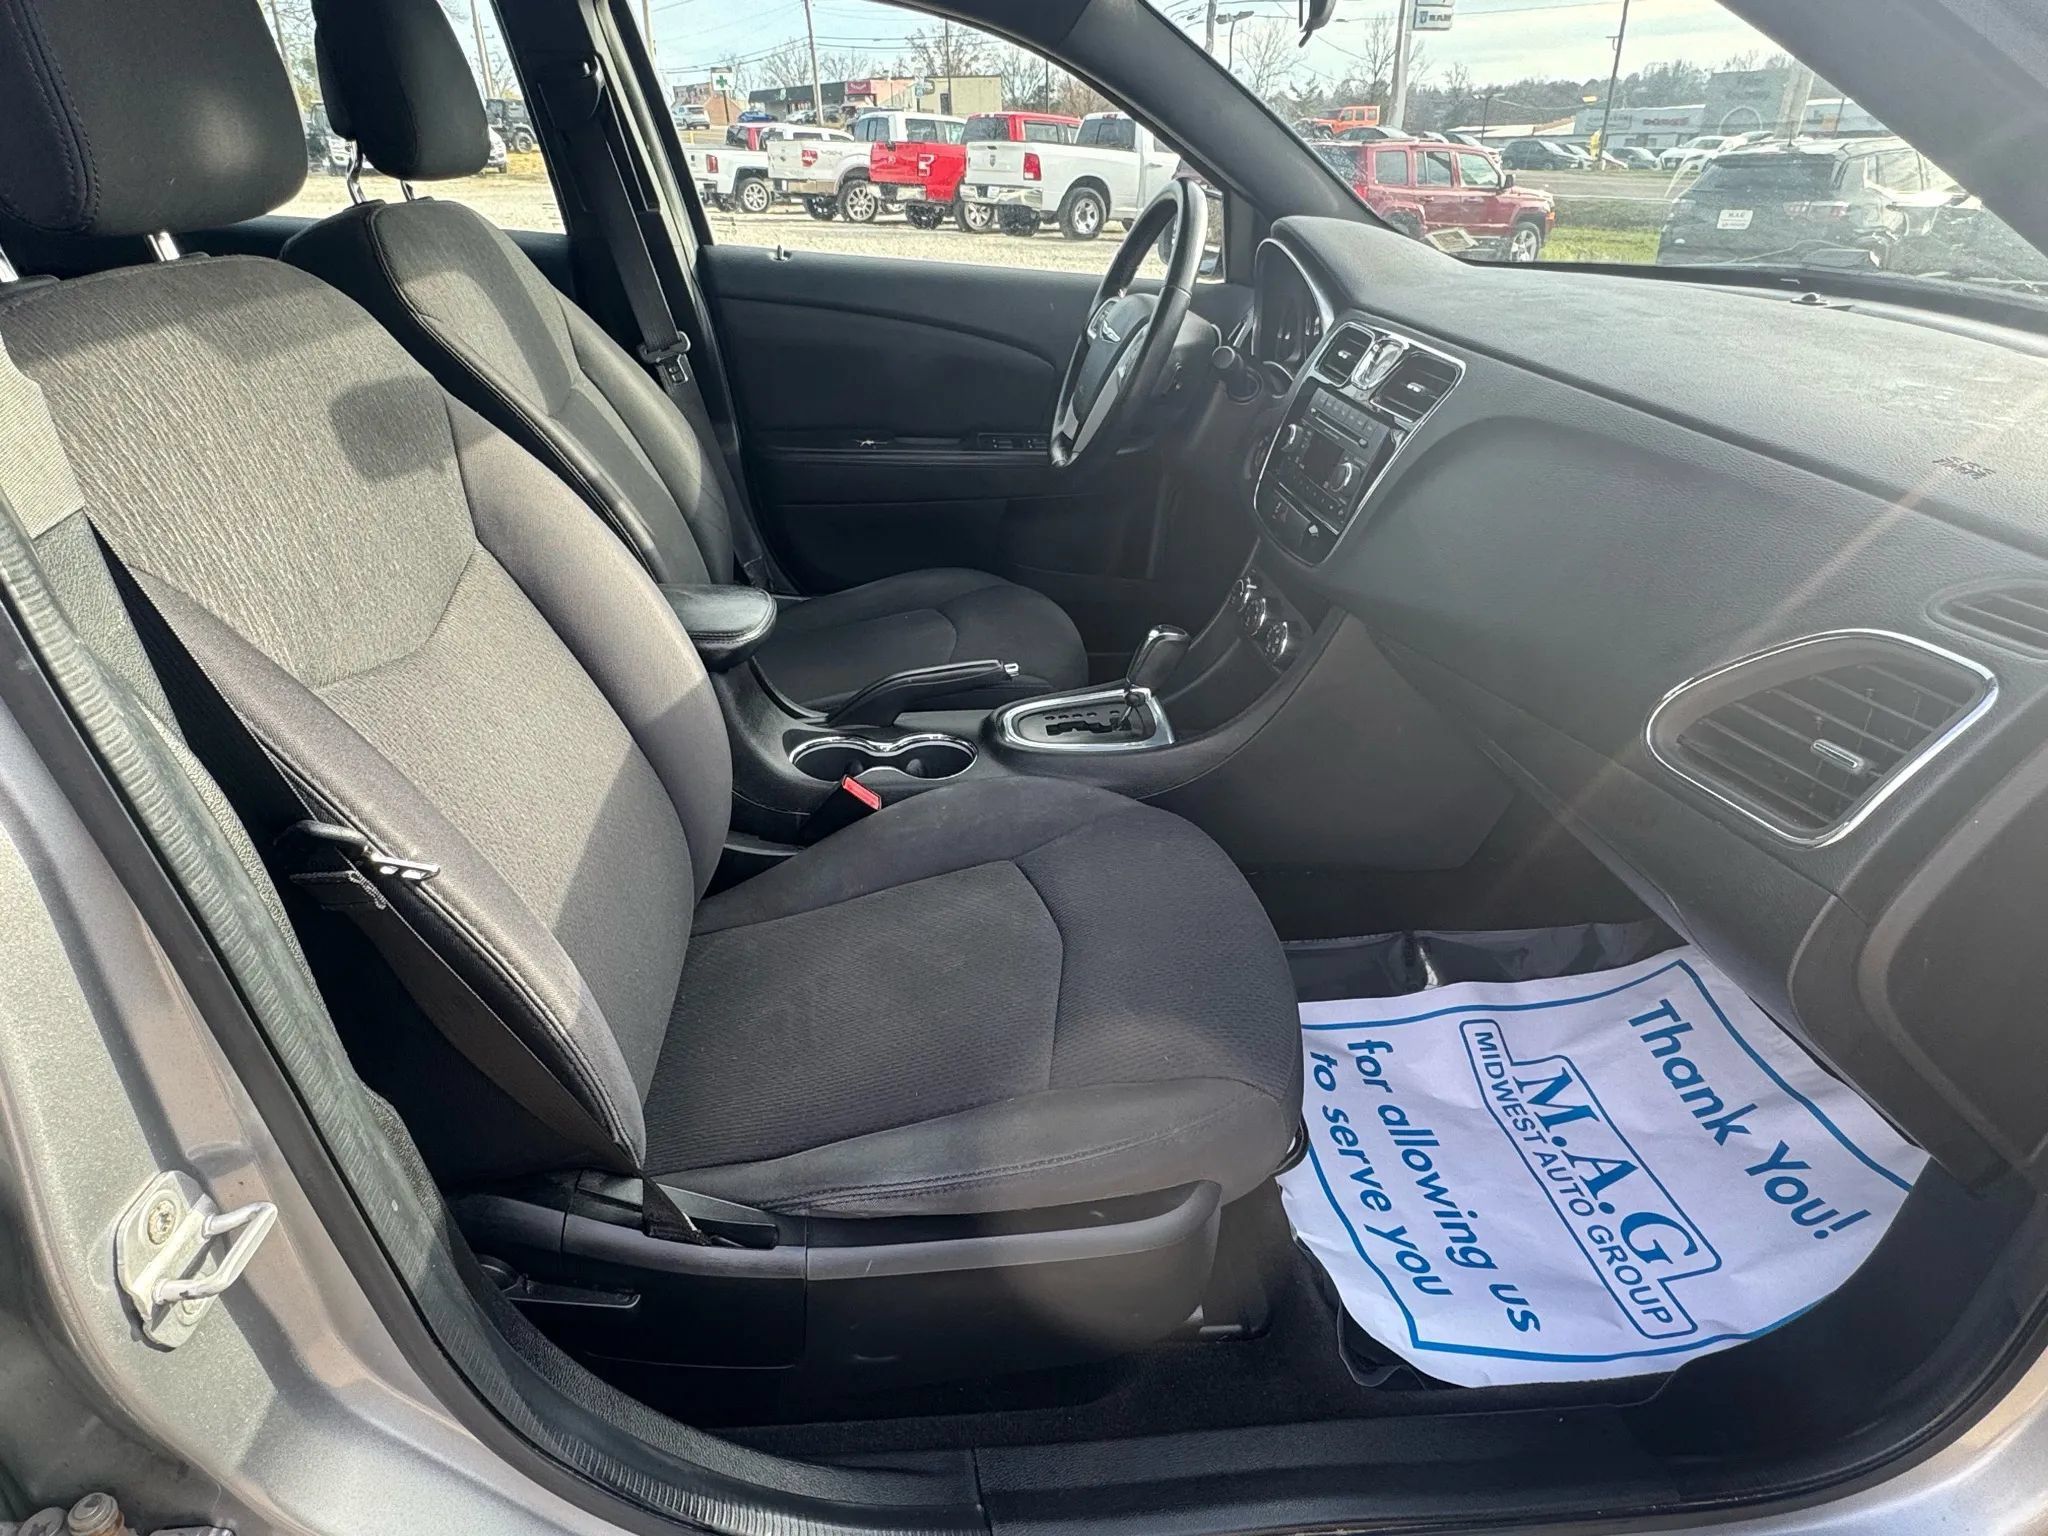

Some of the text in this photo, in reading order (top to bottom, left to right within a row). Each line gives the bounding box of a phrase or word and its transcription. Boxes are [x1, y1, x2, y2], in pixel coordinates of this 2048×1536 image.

[1309, 1051, 1454, 1298] to serve you
[1347, 1038, 1542, 1335] for allowing us
[1474, 1030, 1674, 1326] MIDWEST AUTO GROUP
[1628, 999, 1872, 1240] Thank You!
